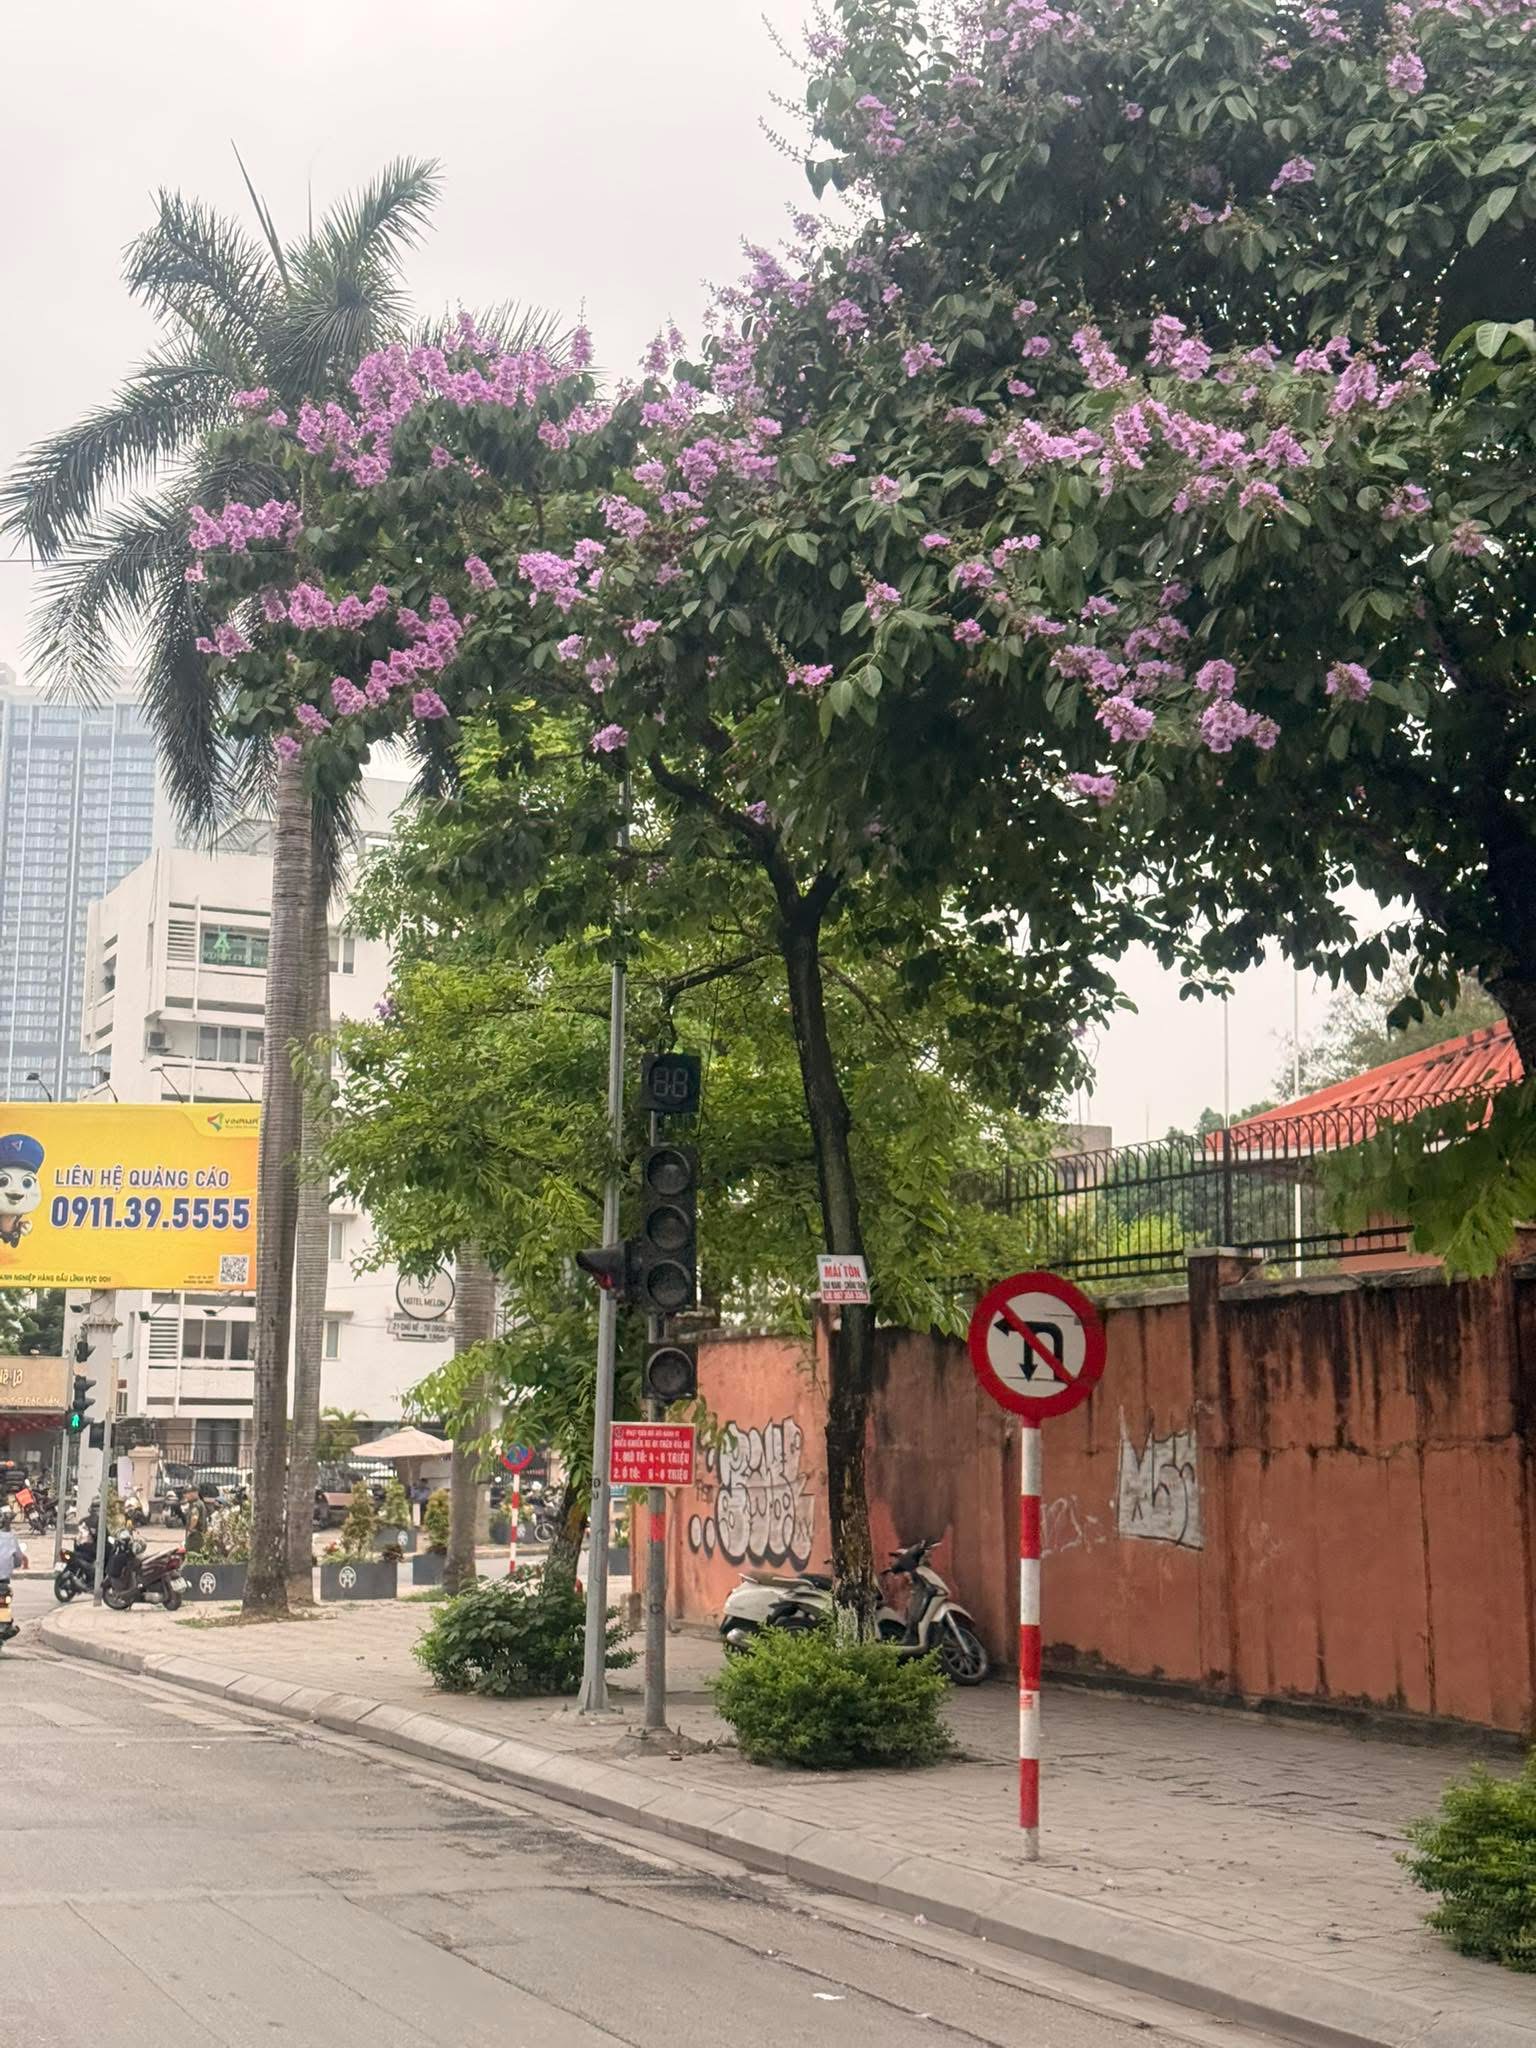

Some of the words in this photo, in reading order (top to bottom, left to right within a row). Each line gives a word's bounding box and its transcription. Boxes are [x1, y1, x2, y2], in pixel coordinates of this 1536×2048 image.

[55, 1165, 93, 1185] LIÊN
[101, 1164, 122, 1191] HỆ
[129, 1166, 188, 1186] QUẢNG
[195, 1166, 230, 1187] CÁO
[51, 1196, 250, 1229] 0911.39.5555
[403, 1296, 423, 1307] HOTEL
[667, 1450, 690, 1465] TRIỆU
[667, 1468, 689, 1482] TRIỆU
